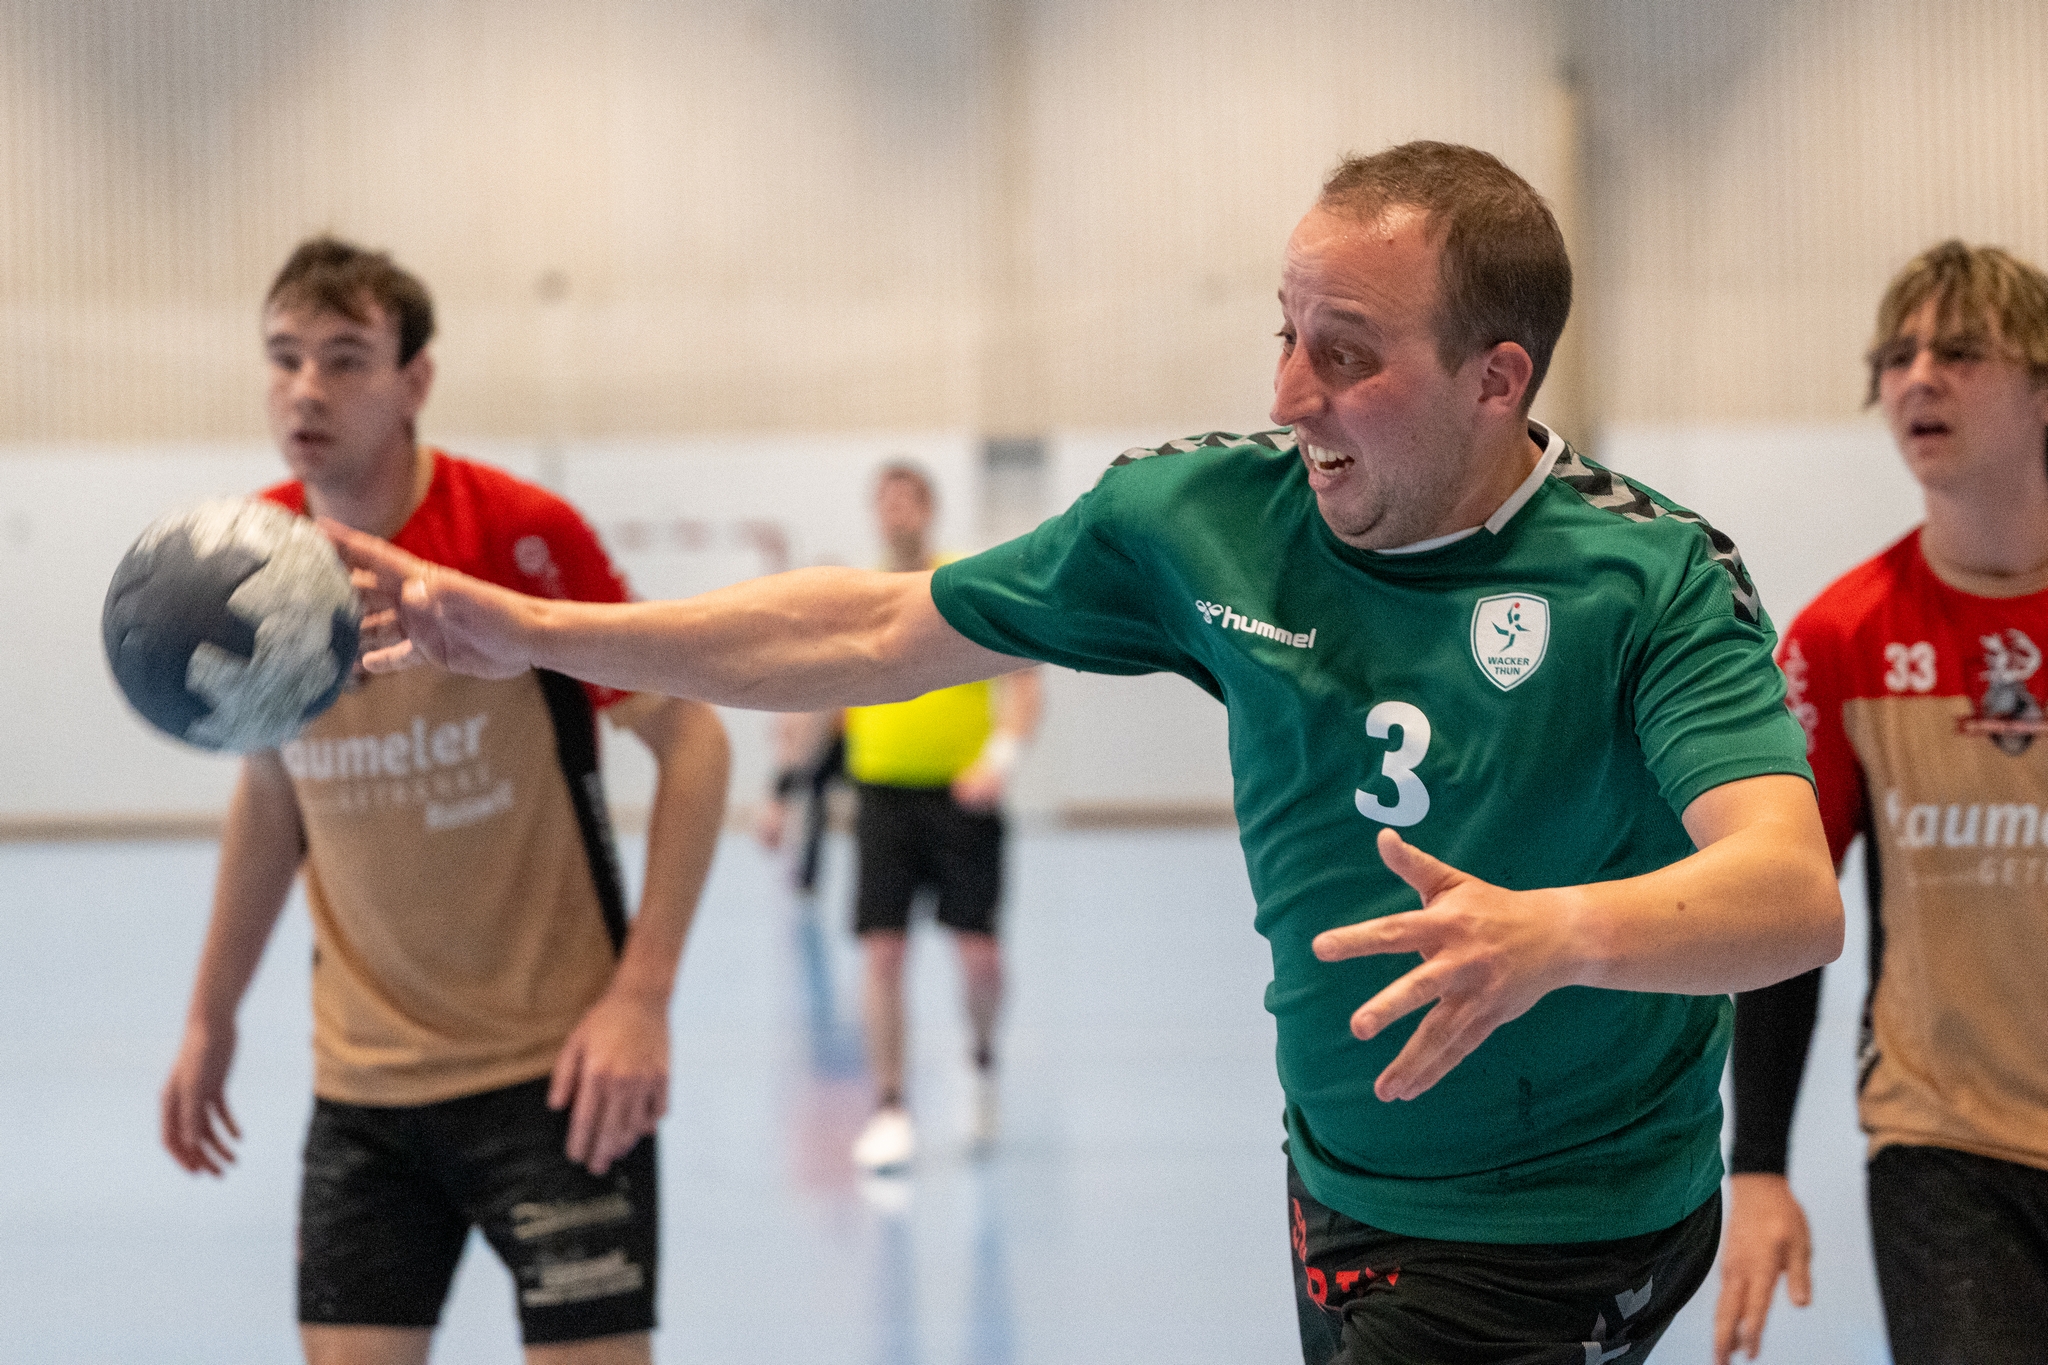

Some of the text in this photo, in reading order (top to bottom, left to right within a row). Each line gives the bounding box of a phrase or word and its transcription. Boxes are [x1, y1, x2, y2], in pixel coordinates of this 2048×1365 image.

[1221, 606, 1317, 648] hummel
[1487, 656, 1530, 666] WACKER
[1494, 666, 1520, 676] THUN
[1884, 641, 1937, 693] 33
[1355, 700, 1431, 827] 3
